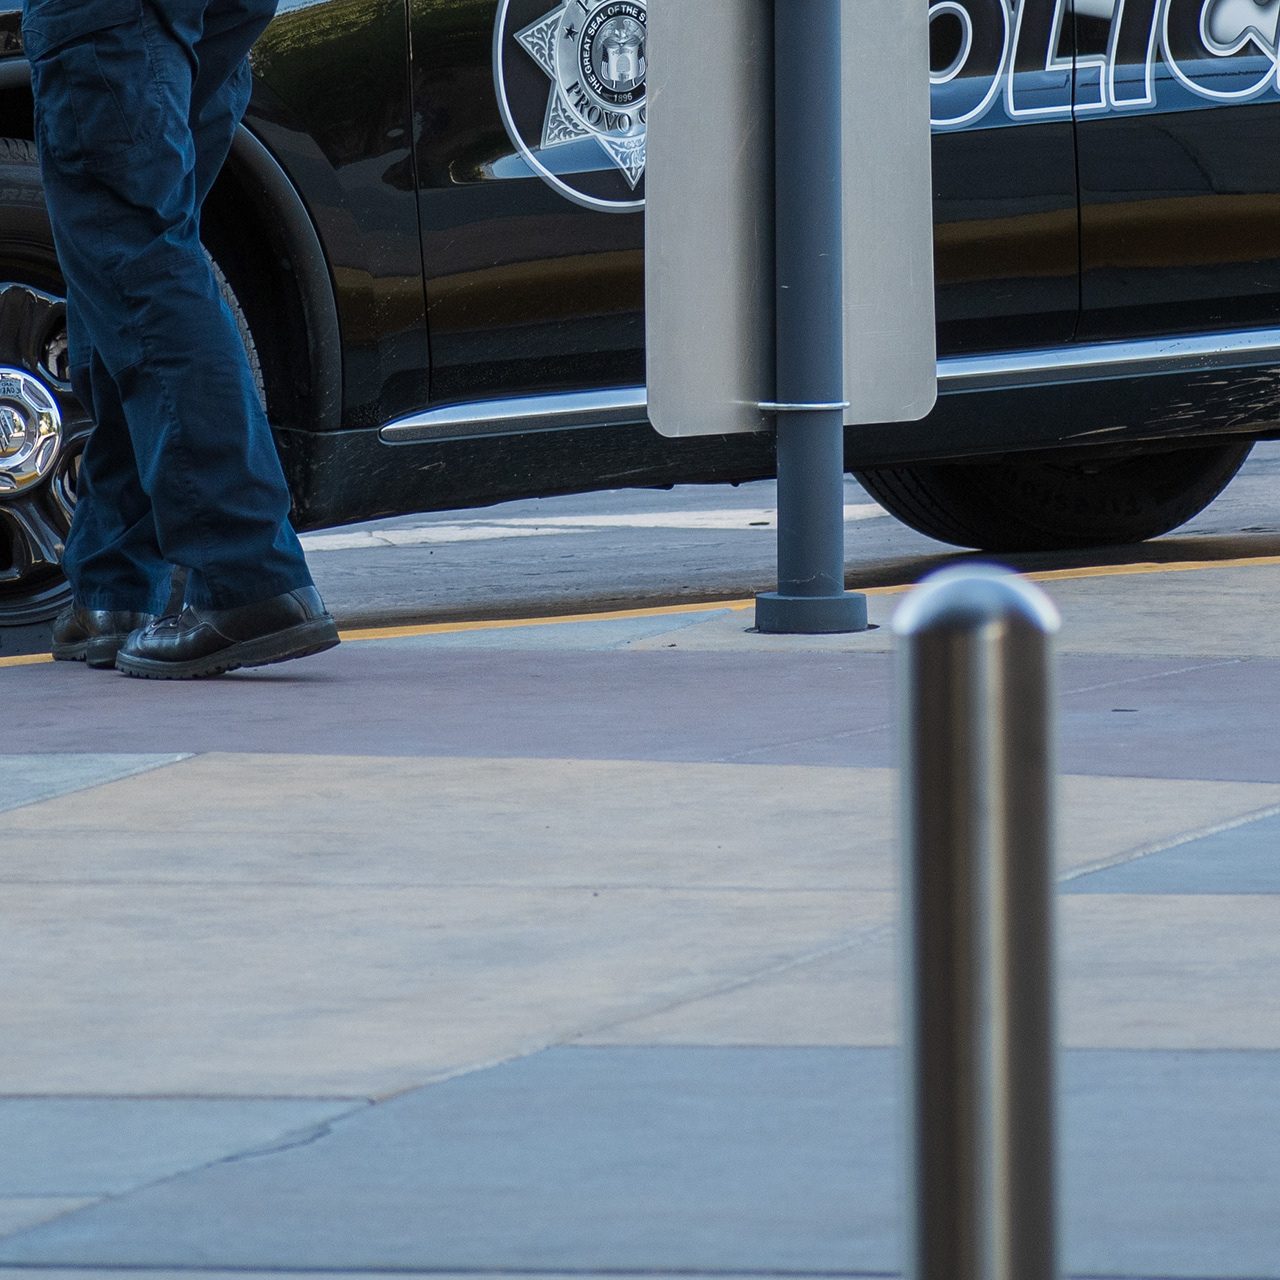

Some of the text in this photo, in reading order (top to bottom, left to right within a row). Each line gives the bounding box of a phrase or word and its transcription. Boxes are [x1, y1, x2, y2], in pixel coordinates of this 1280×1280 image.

[583, 4, 639, 95] THE GREAT SEAL OF THE
[565, 80, 631, 134] PROVO
